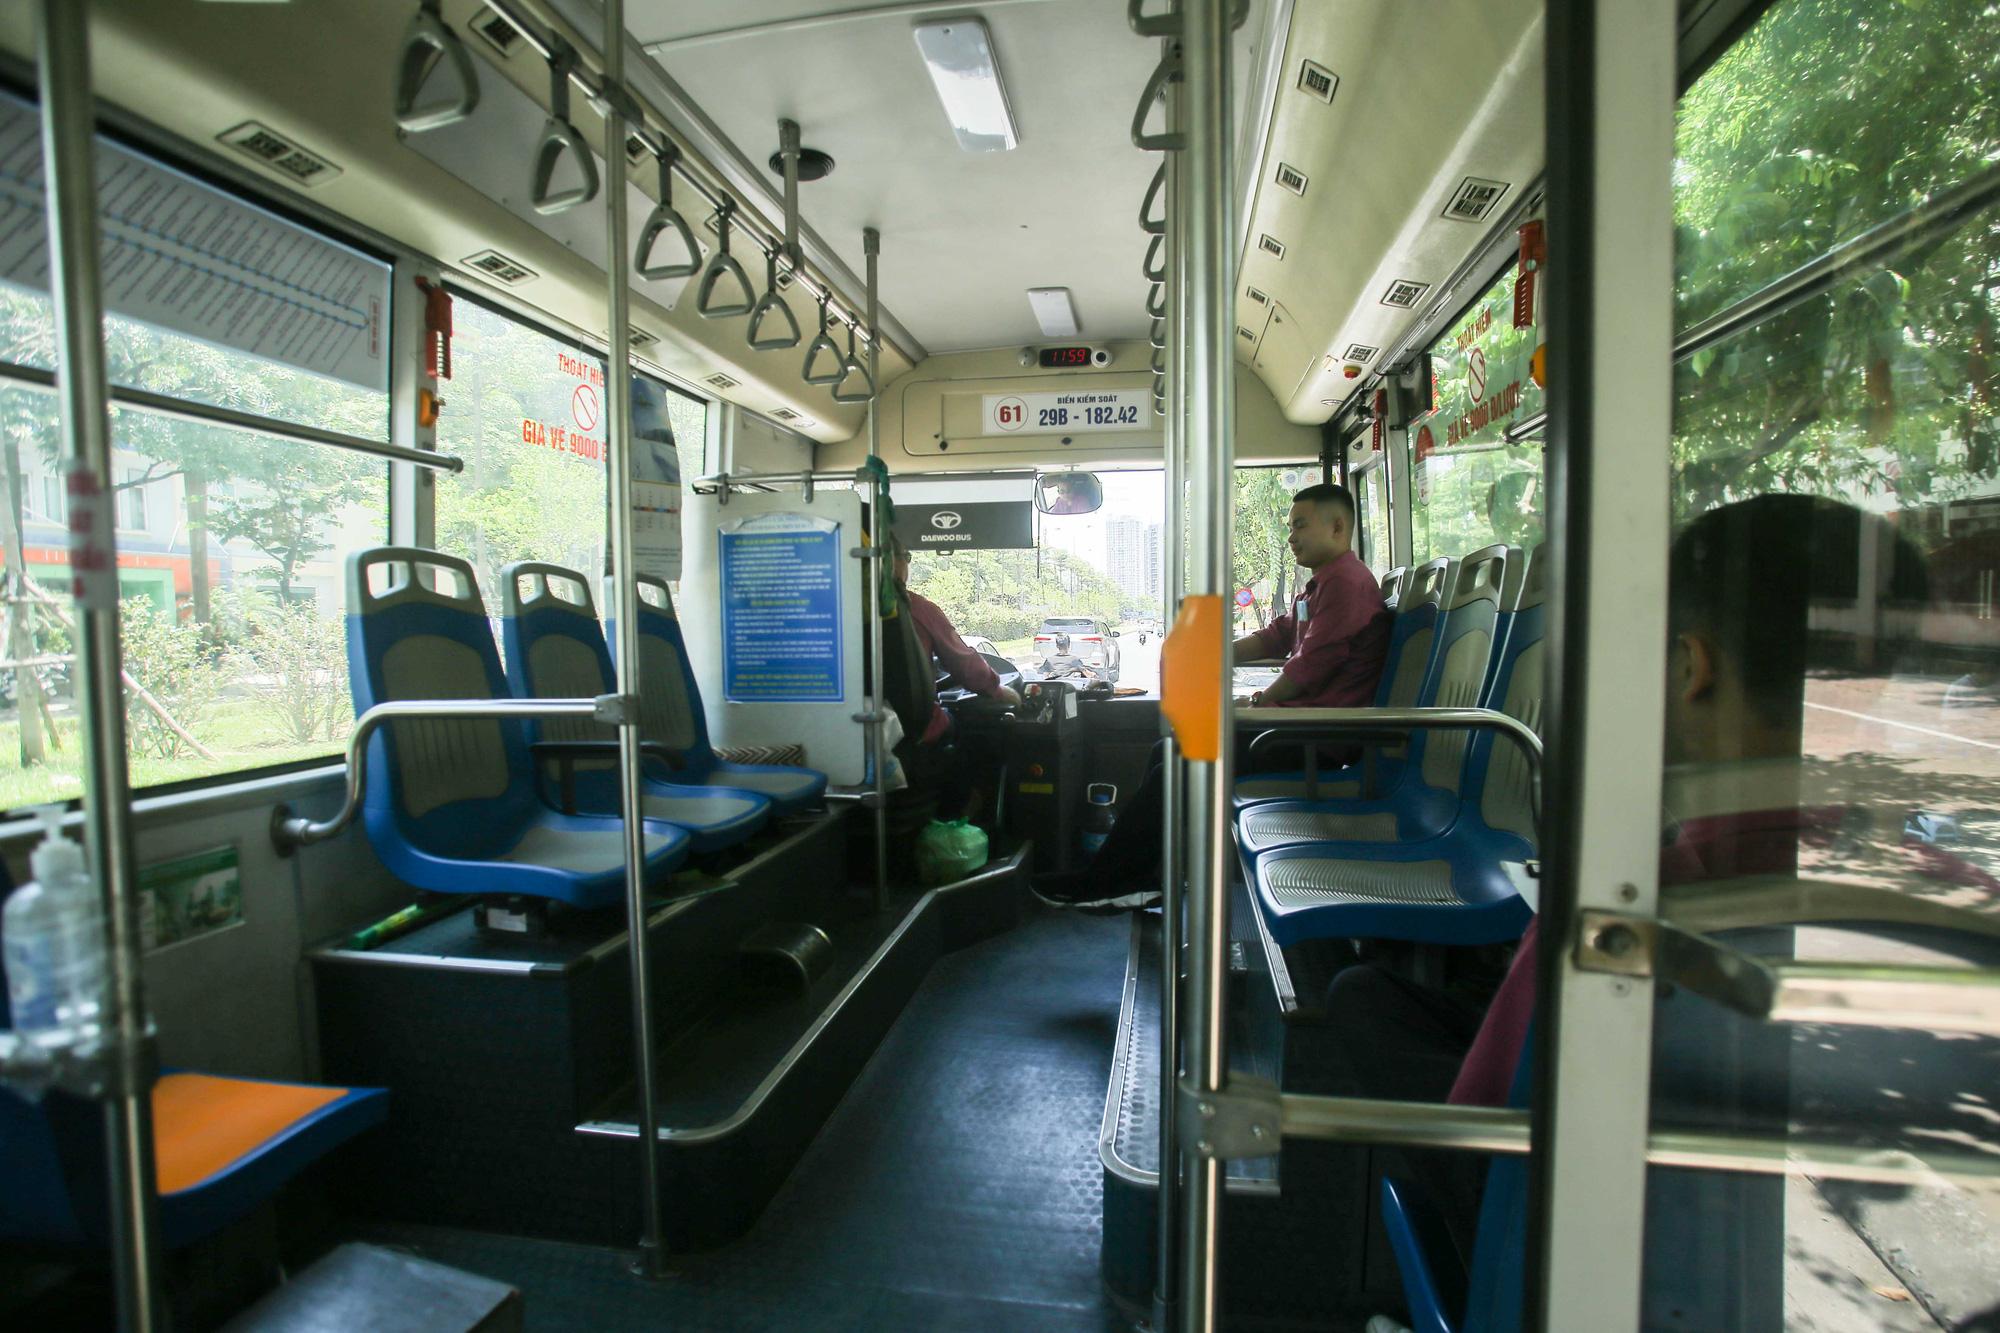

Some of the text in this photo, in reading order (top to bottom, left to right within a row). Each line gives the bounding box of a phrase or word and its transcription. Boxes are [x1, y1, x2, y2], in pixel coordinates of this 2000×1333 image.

[1098, 394, 1118, 403] SOÁT
[999, 405, 1021, 423] 61
[1039, 408, 1068, 426] 29B
[1084, 405, 1138, 425] 182.42
[1470, 401, 1489, 432] 9000
[570, 433, 599, 460] 9000
[921, 533, 972, 542] DAEWOO BUS
